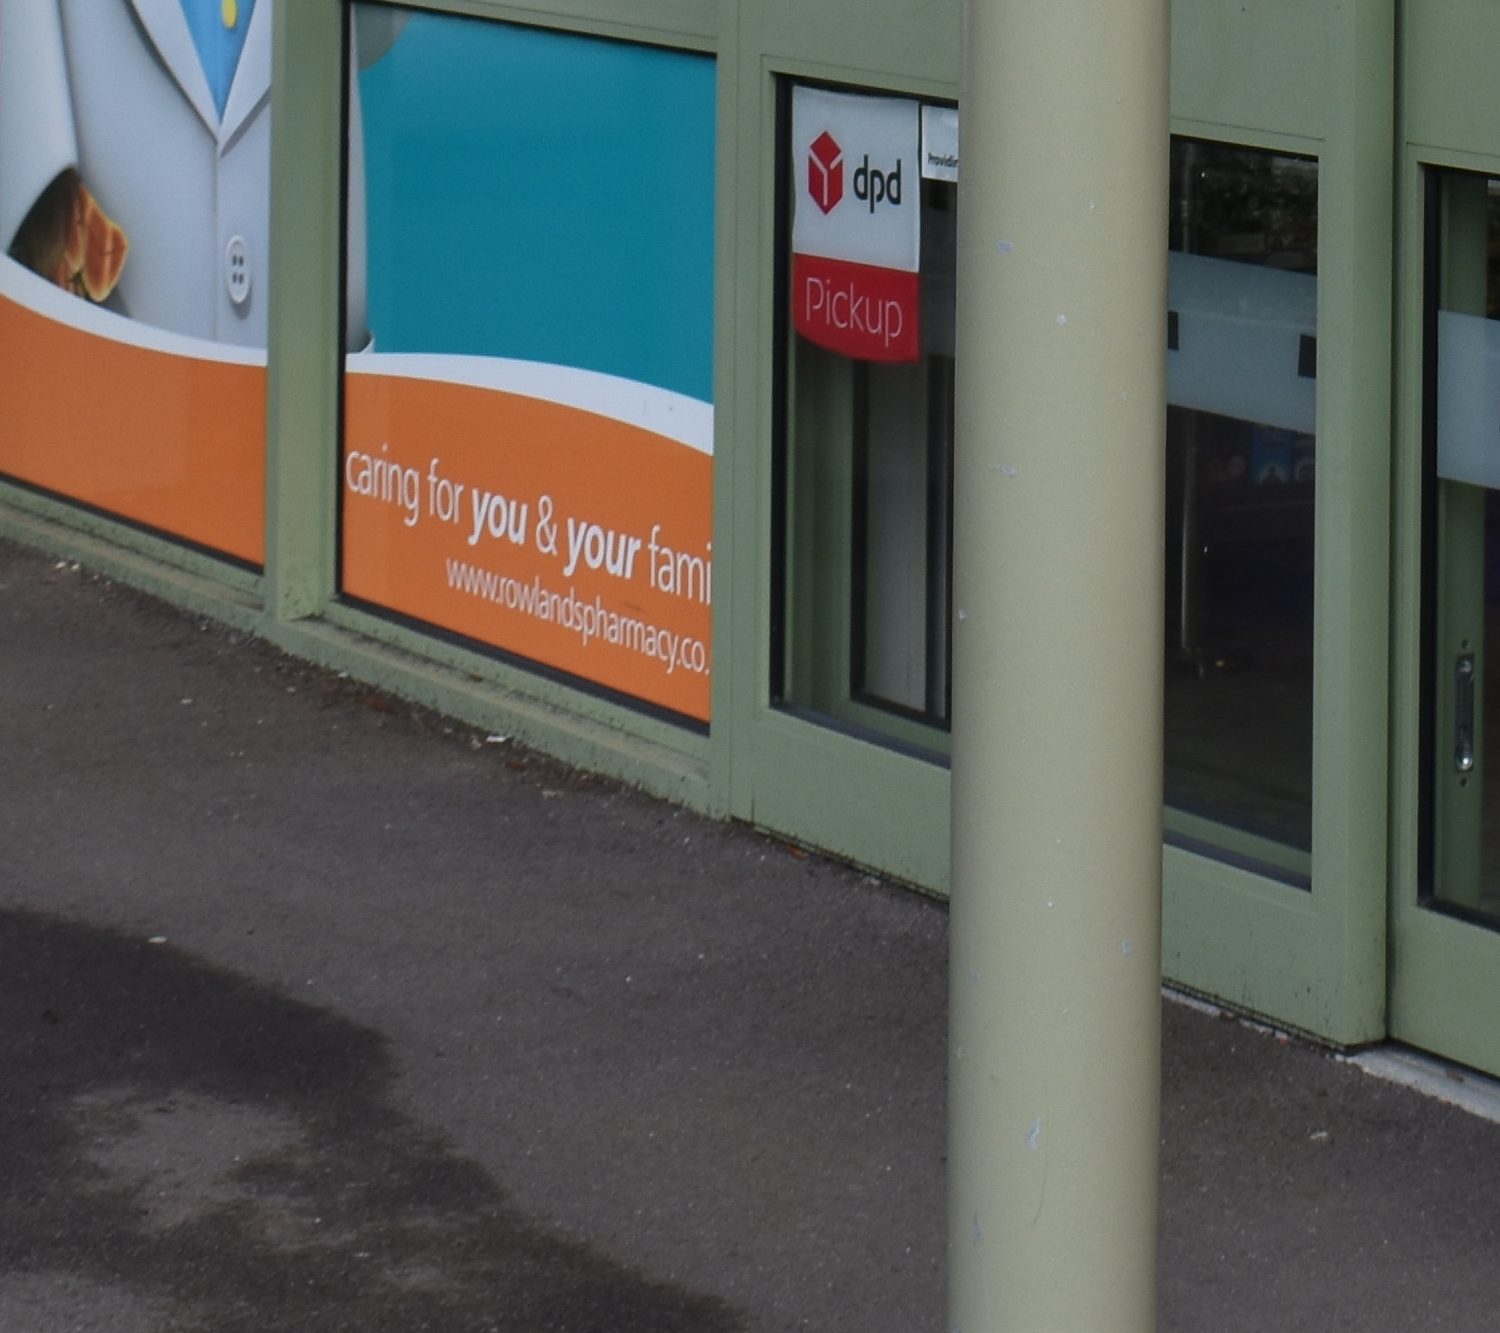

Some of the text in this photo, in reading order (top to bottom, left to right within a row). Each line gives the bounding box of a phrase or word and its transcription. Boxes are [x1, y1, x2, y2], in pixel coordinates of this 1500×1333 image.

[853, 154, 902, 214] dpd
[805, 277, 903, 349] Pickup
[346, 443, 420, 527] caring
[428, 457, 464, 524] for
[467, 487, 529, 546] you
[535, 494, 558, 557] &
[562, 516, 641, 580] your
